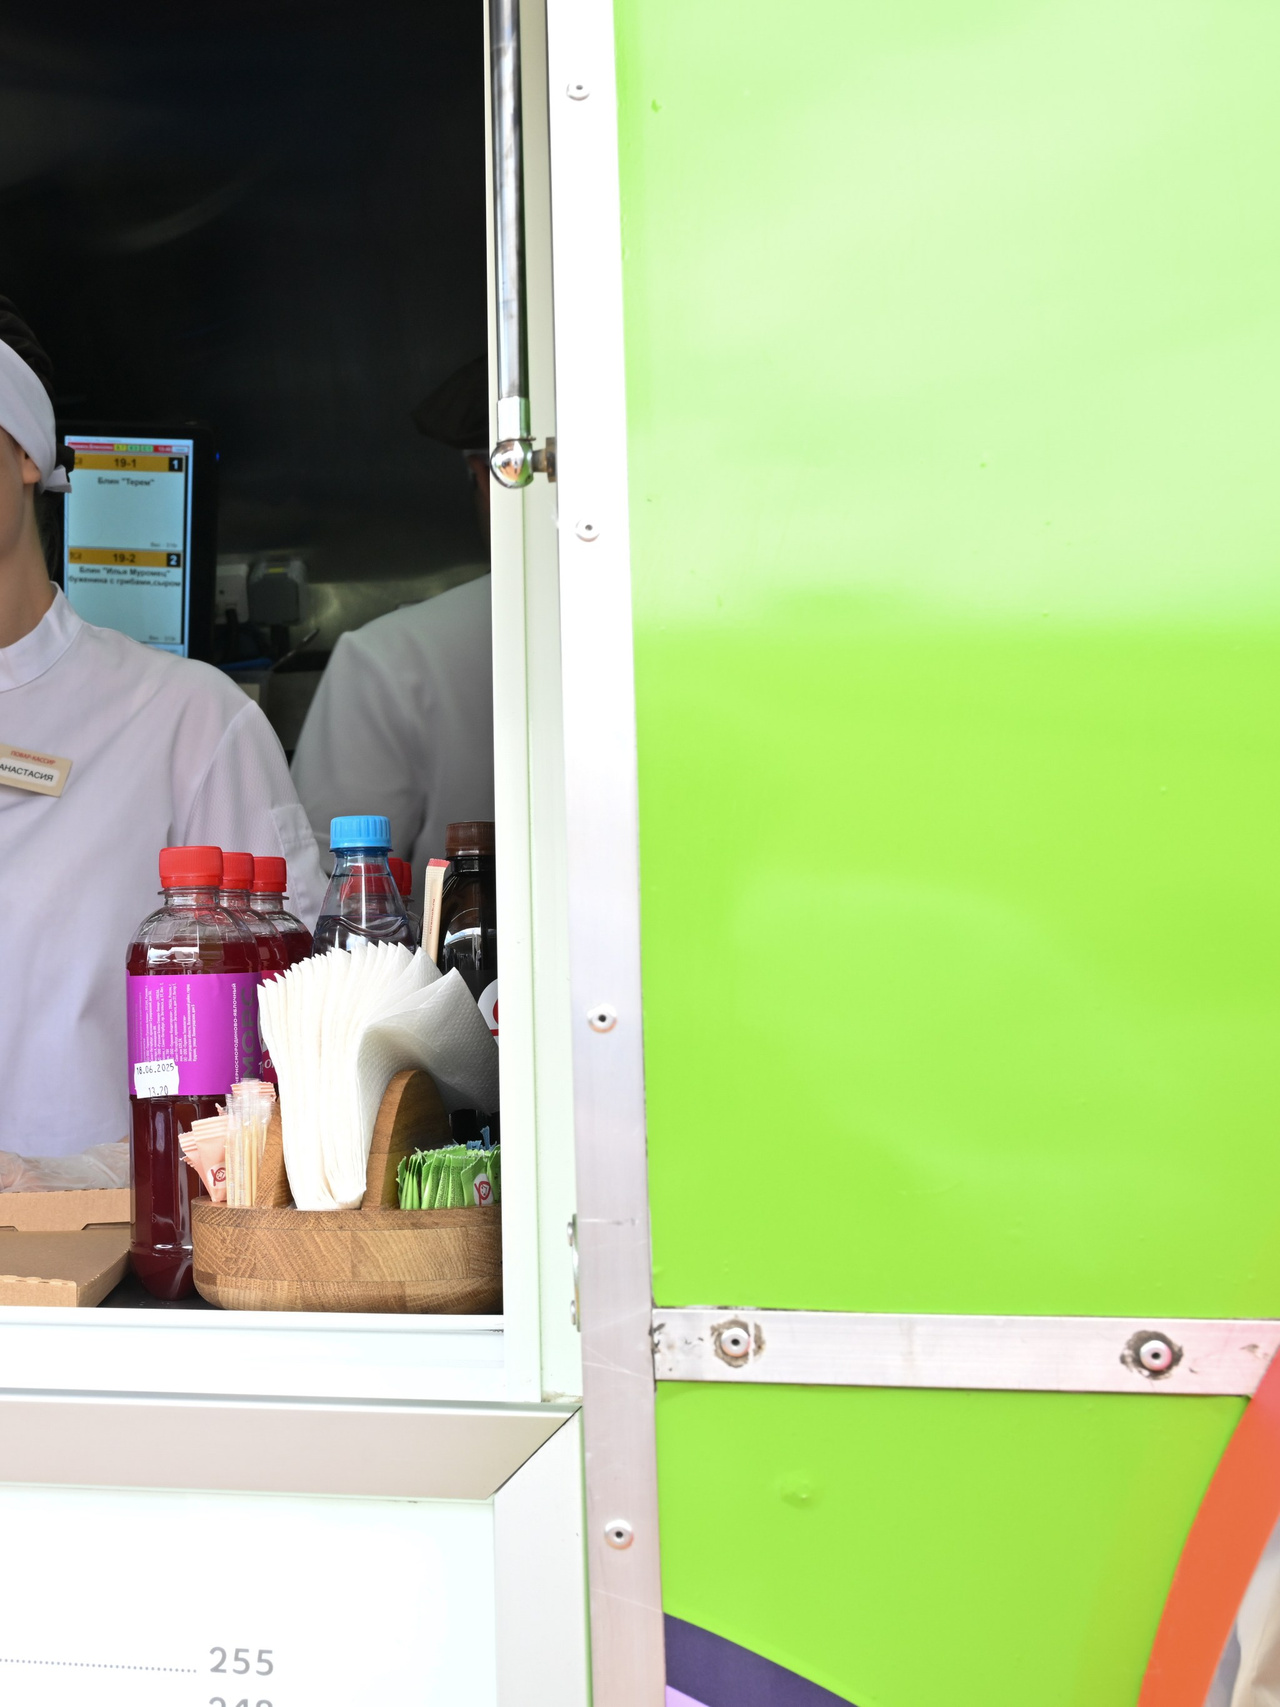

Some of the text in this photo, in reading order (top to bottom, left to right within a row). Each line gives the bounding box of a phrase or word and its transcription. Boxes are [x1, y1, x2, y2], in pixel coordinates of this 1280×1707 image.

[114, 458, 179, 470] 19-1 1
[98, 477, 119, 485] Блин
[113, 553, 178, 566] 19-2 2
[241, 987, 256, 1079] МОРС
[209, 1646, 274, 1676] 255
